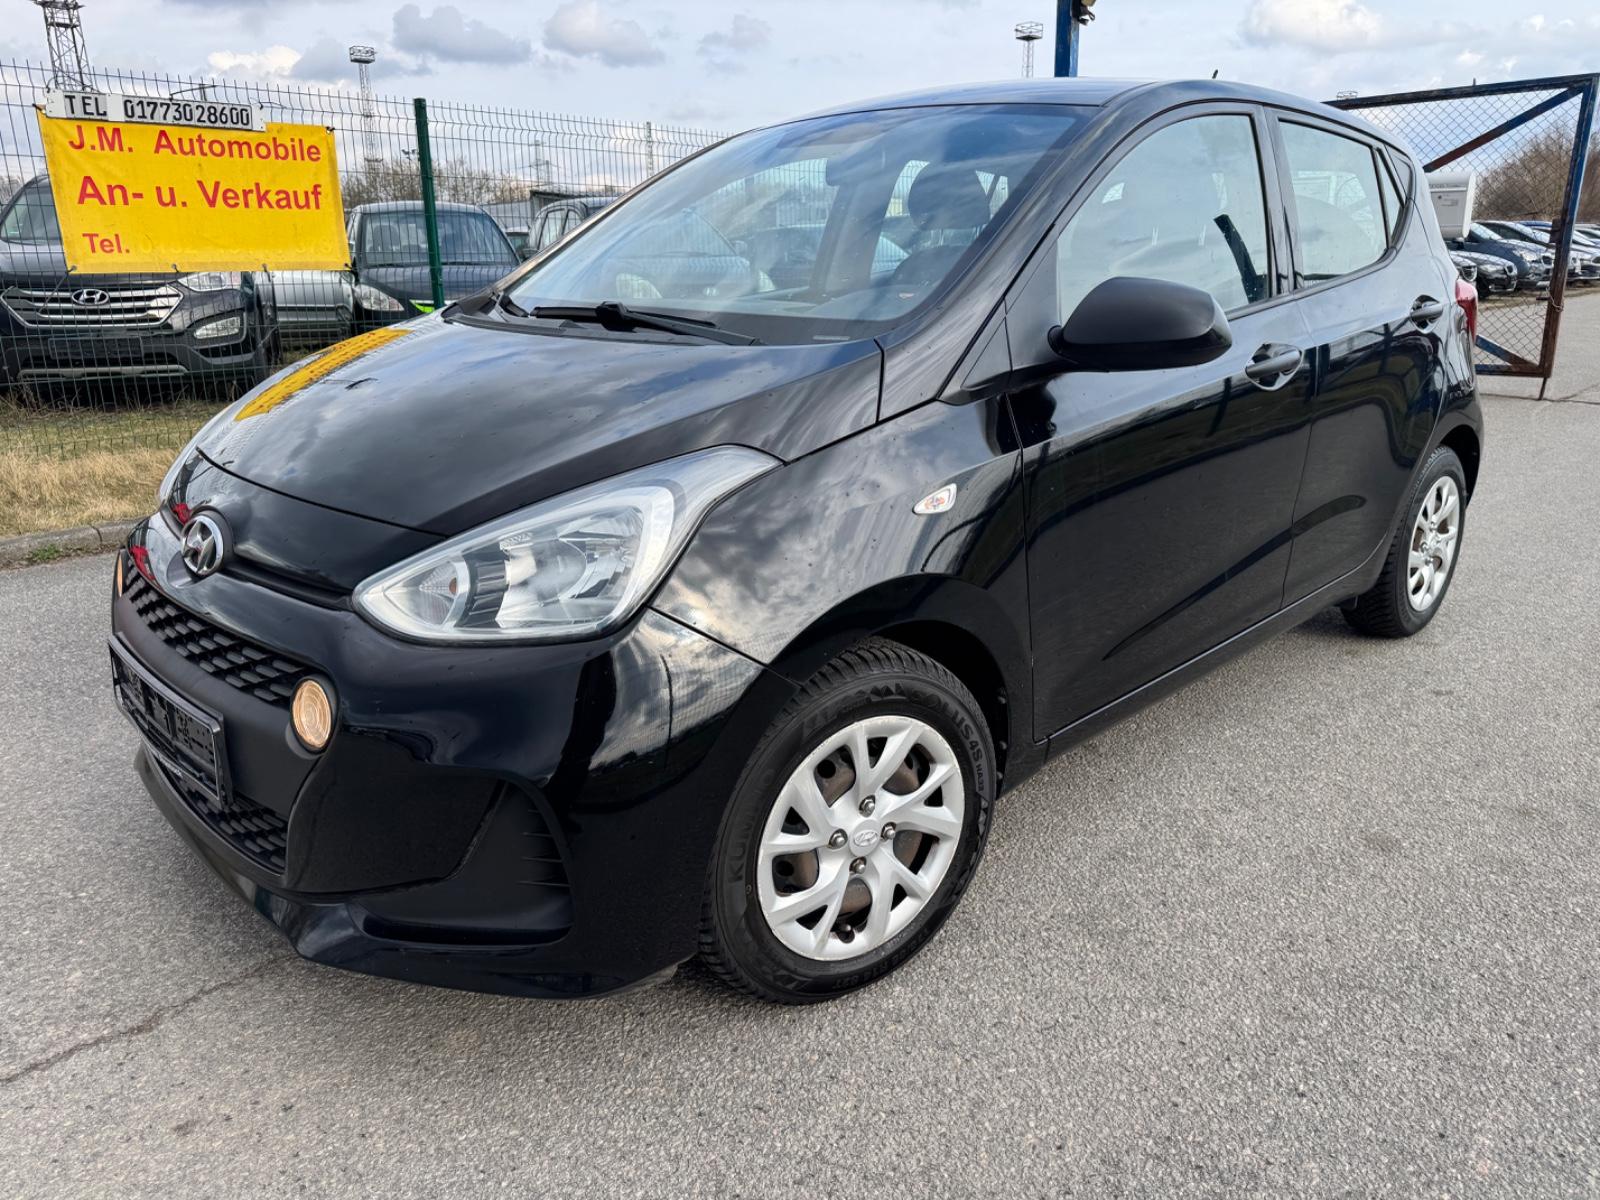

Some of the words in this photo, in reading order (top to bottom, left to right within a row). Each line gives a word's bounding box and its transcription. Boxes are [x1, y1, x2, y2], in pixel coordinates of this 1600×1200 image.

[64, 94, 107, 117] TEL
[123, 99, 250, 126] 01773028600
[68, 125, 134, 153] J.M.
[153, 129, 321, 162] Automobile
[77, 175, 144, 206] An-
[155, 185, 188, 208] u.
[197, 179, 322, 210] Verkauf
[82, 232, 131, 254] Tel.
